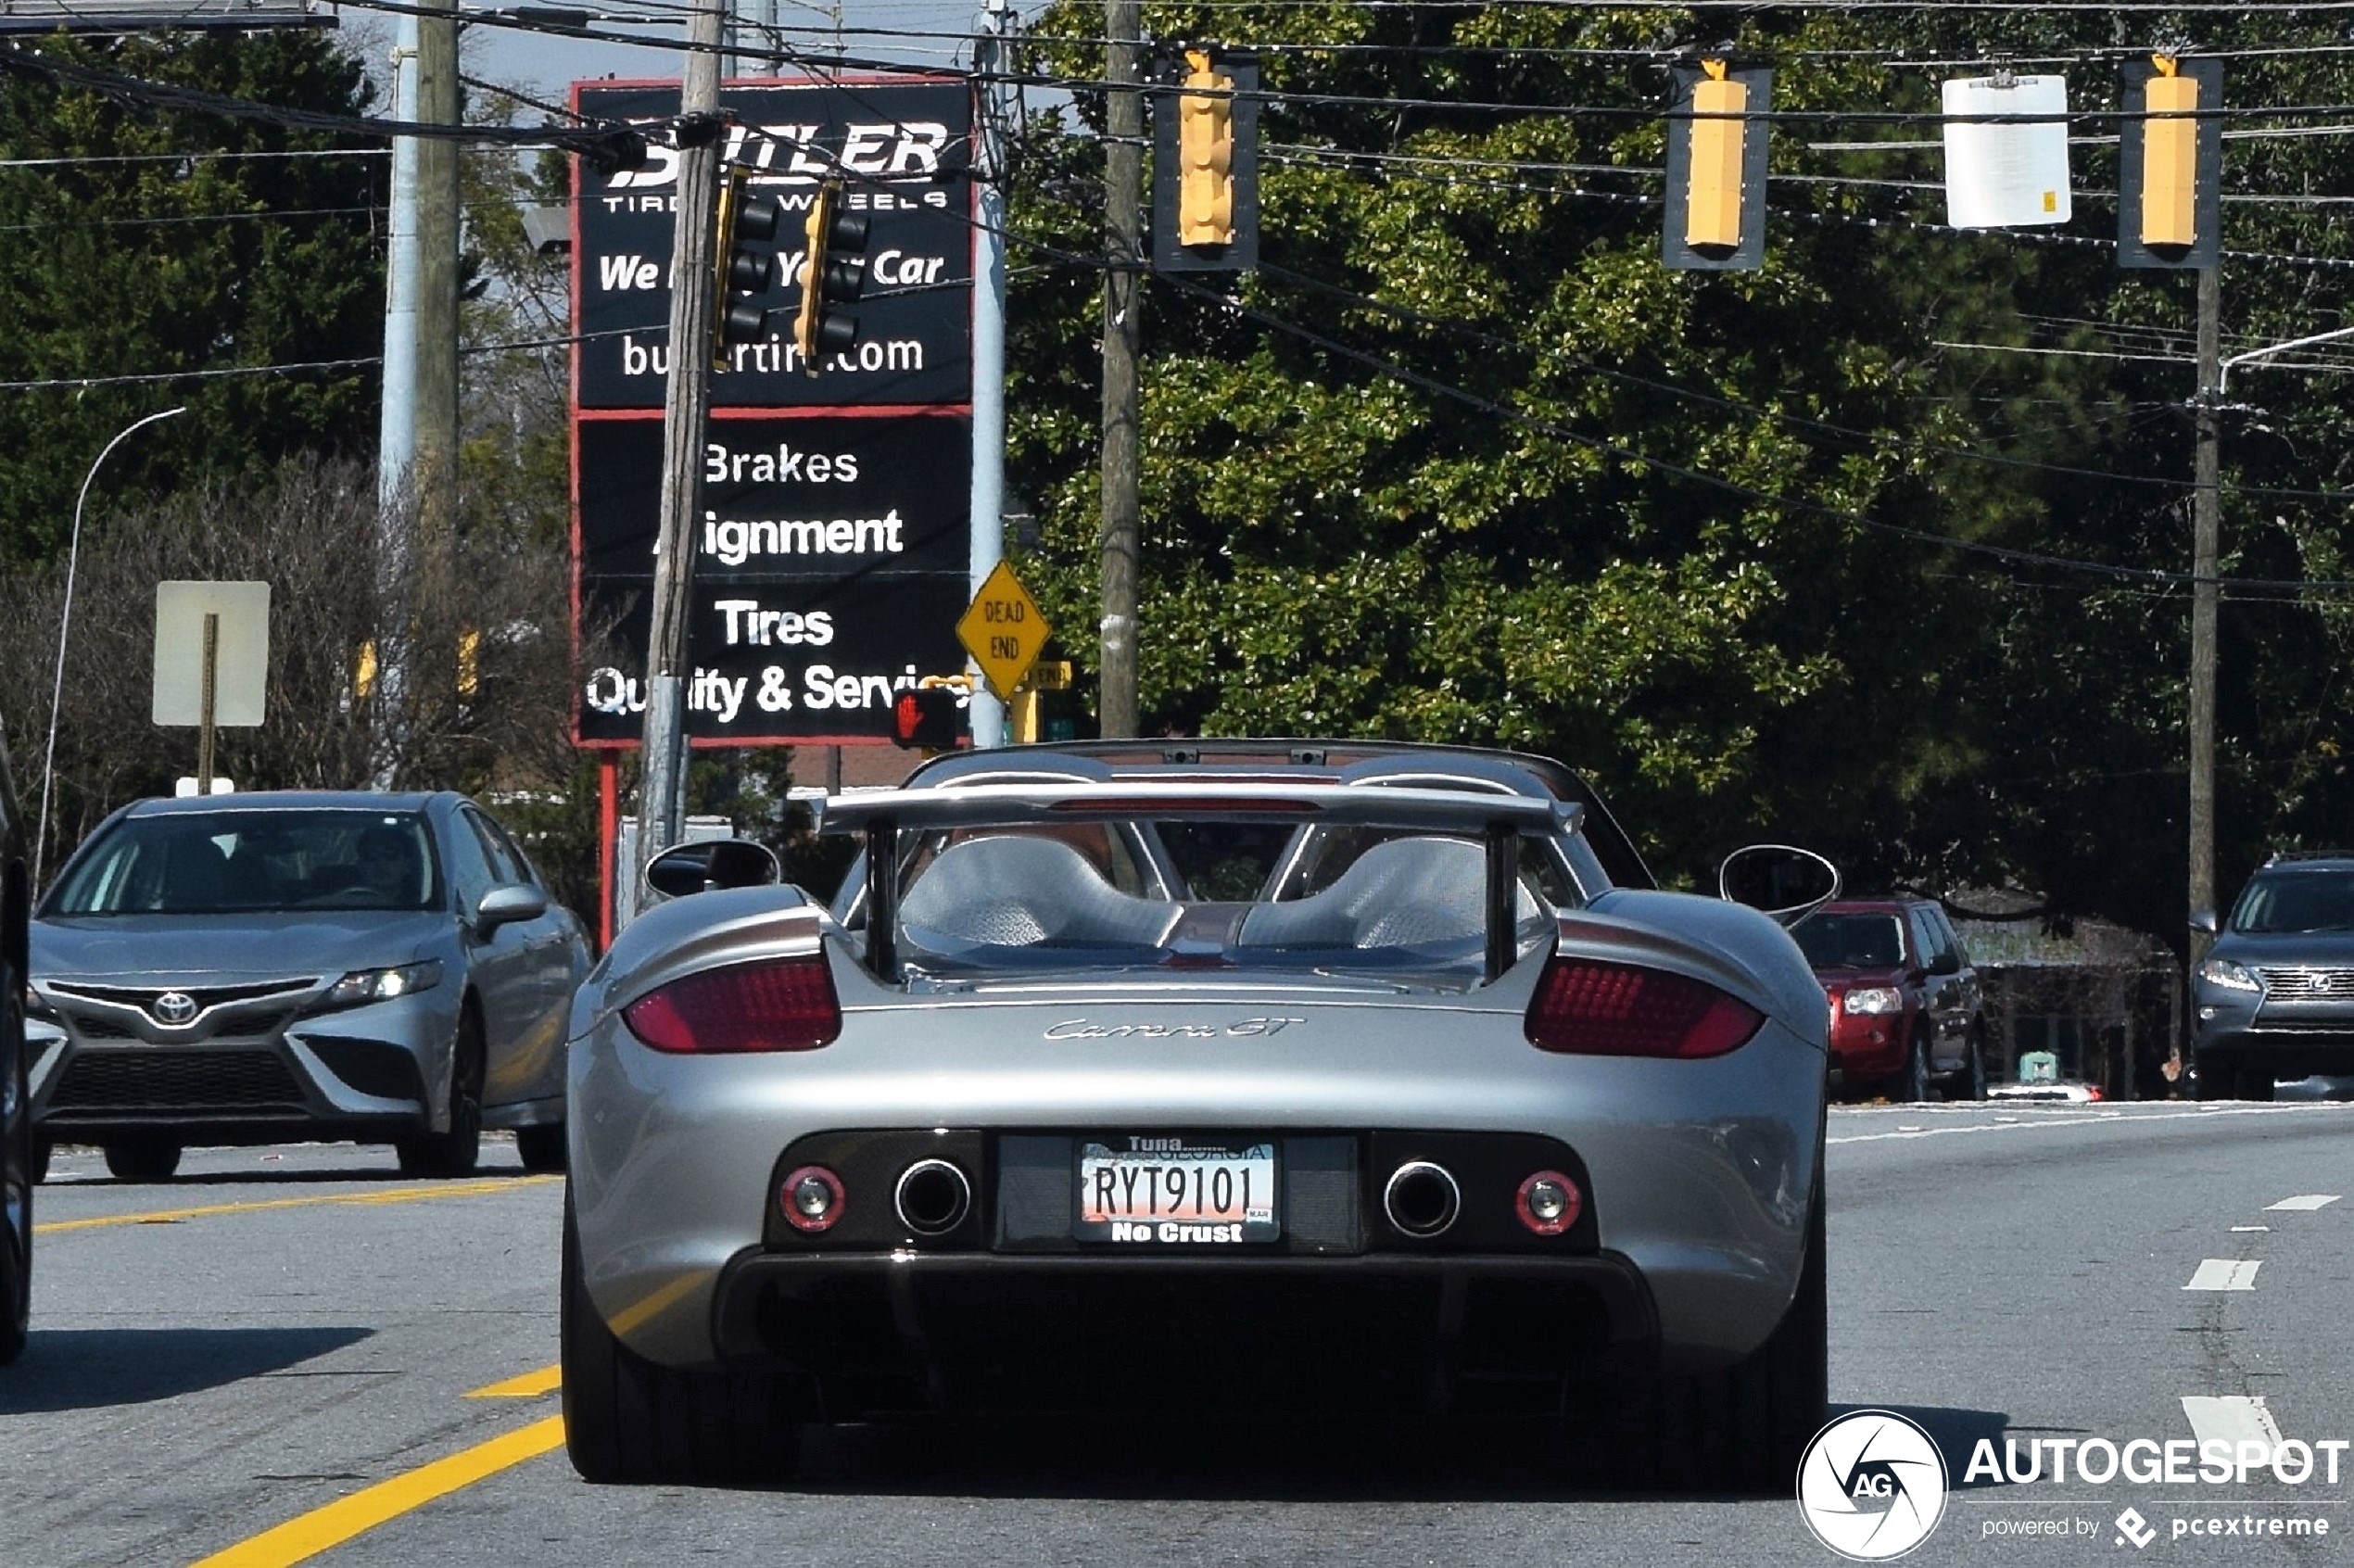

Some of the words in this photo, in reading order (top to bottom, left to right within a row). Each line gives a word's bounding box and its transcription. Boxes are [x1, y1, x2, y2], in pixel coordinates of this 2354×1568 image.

[777, 192, 947, 210] WEELS
[600, 255, 658, 291] We
[874, 249, 943, 285] Car
[706, 443, 858, 483] Brakes
[652, 510, 903, 565] ignment
[715, 600, 834, 646] Tires
[985, 601, 1024, 623] DEAD
[991, 637, 1019, 660] END
[587, 666, 748, 723] Quity
[756, 664, 792, 712] &
[1044, 1018, 1217, 1040] Carrera
[1226, 1018, 1308, 1037] GT
[1095, 1166, 1250, 1215] RYT9101
[1112, 1222, 1151, 1242] No
[1158, 1222, 1243, 1243] Crust
